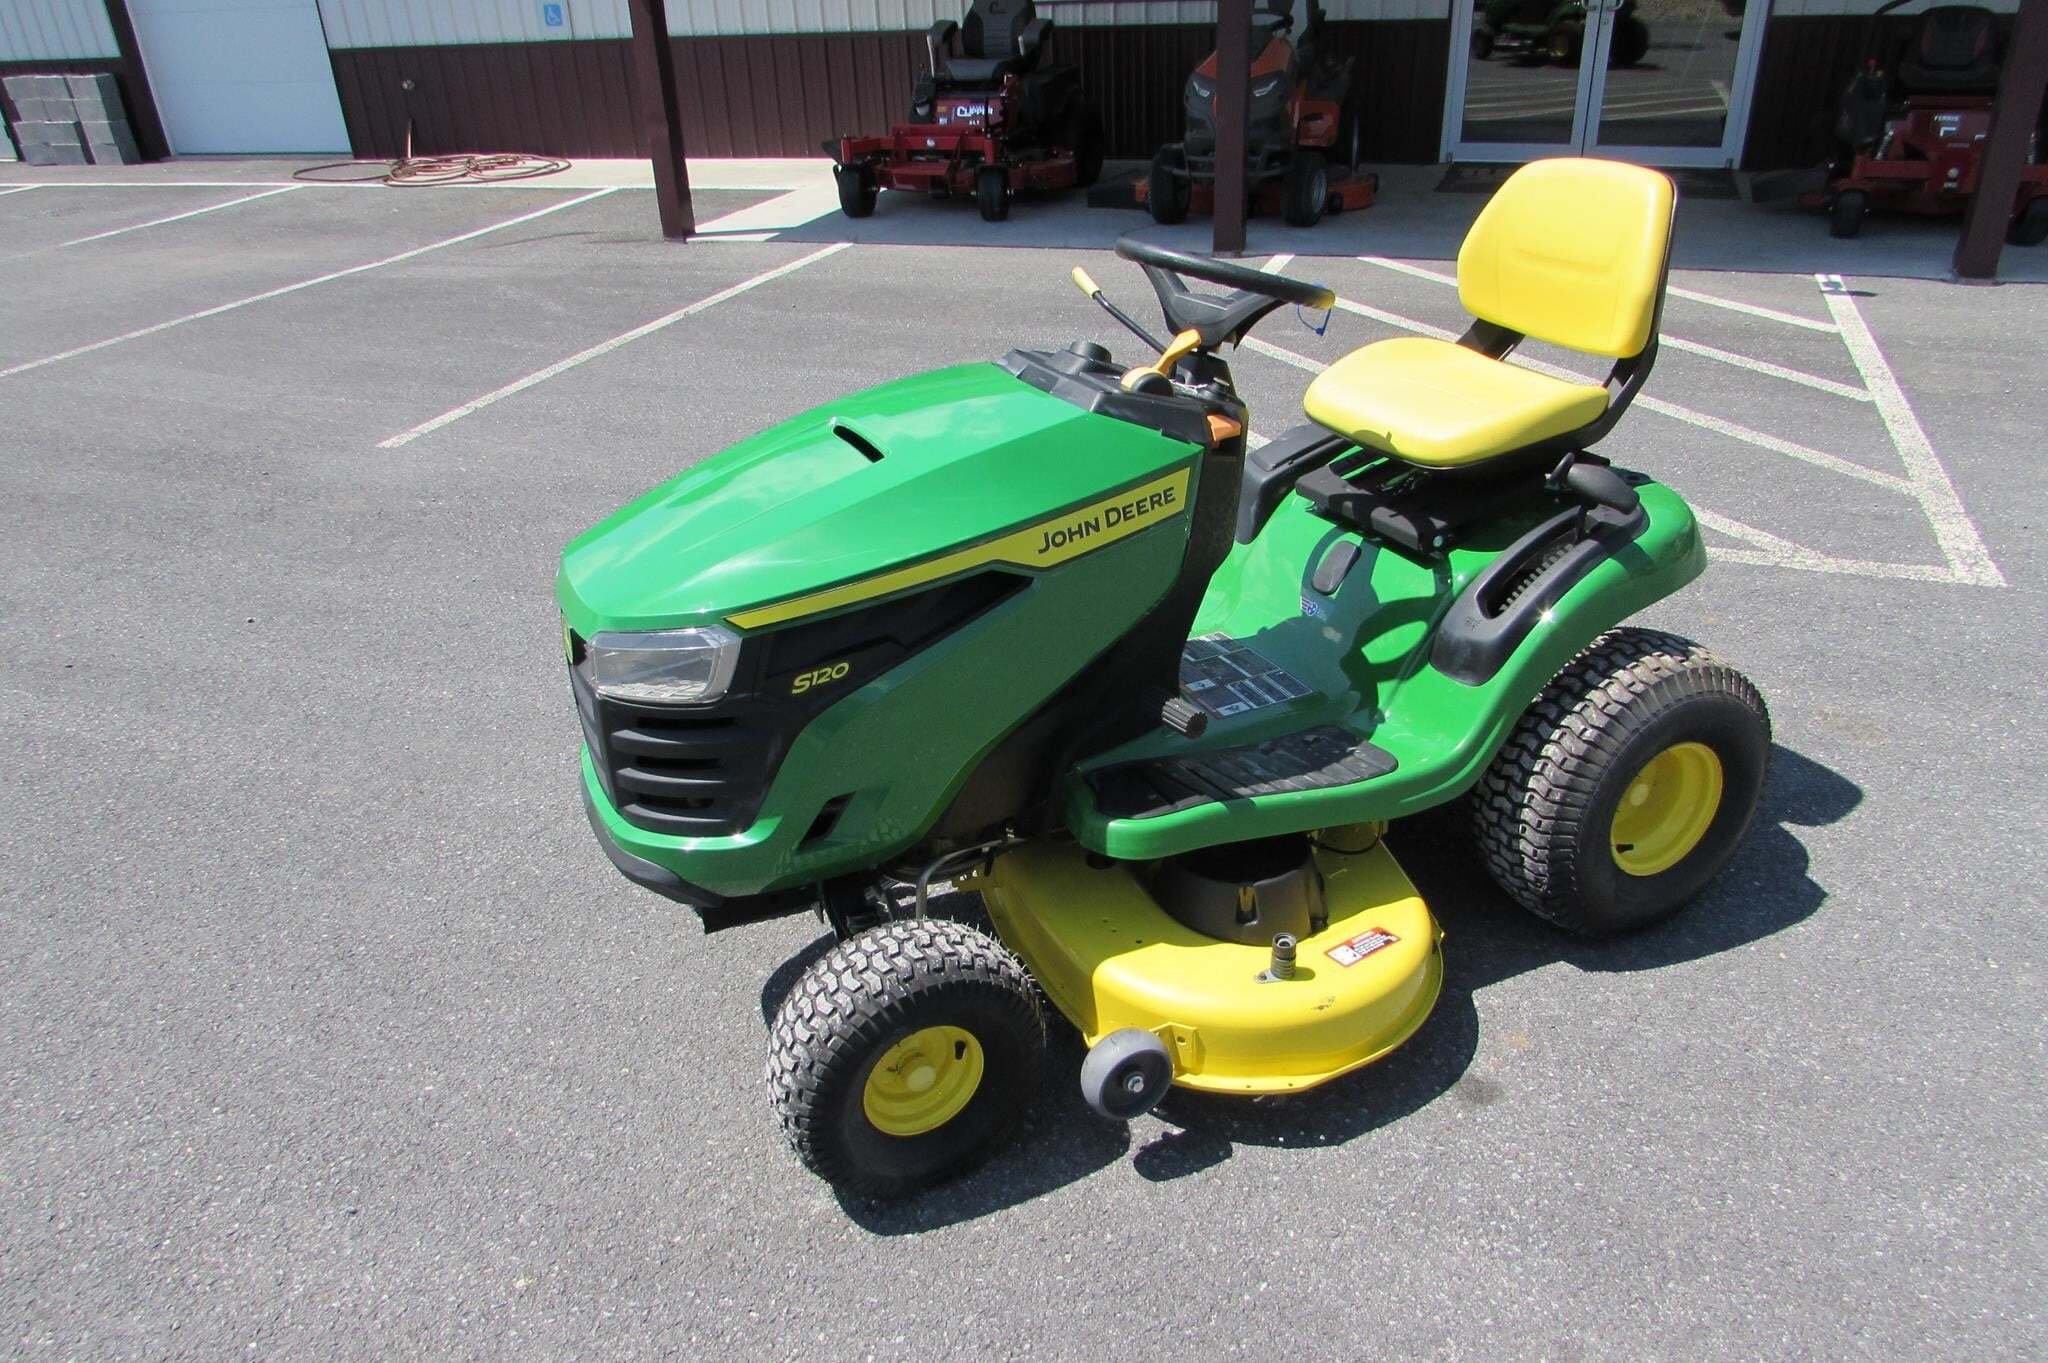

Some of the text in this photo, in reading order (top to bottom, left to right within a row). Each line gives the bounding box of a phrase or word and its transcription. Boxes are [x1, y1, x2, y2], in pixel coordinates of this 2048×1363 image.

[1038, 487, 1176, 554] JOHN DEERE
[792, 662, 849, 694] S120
